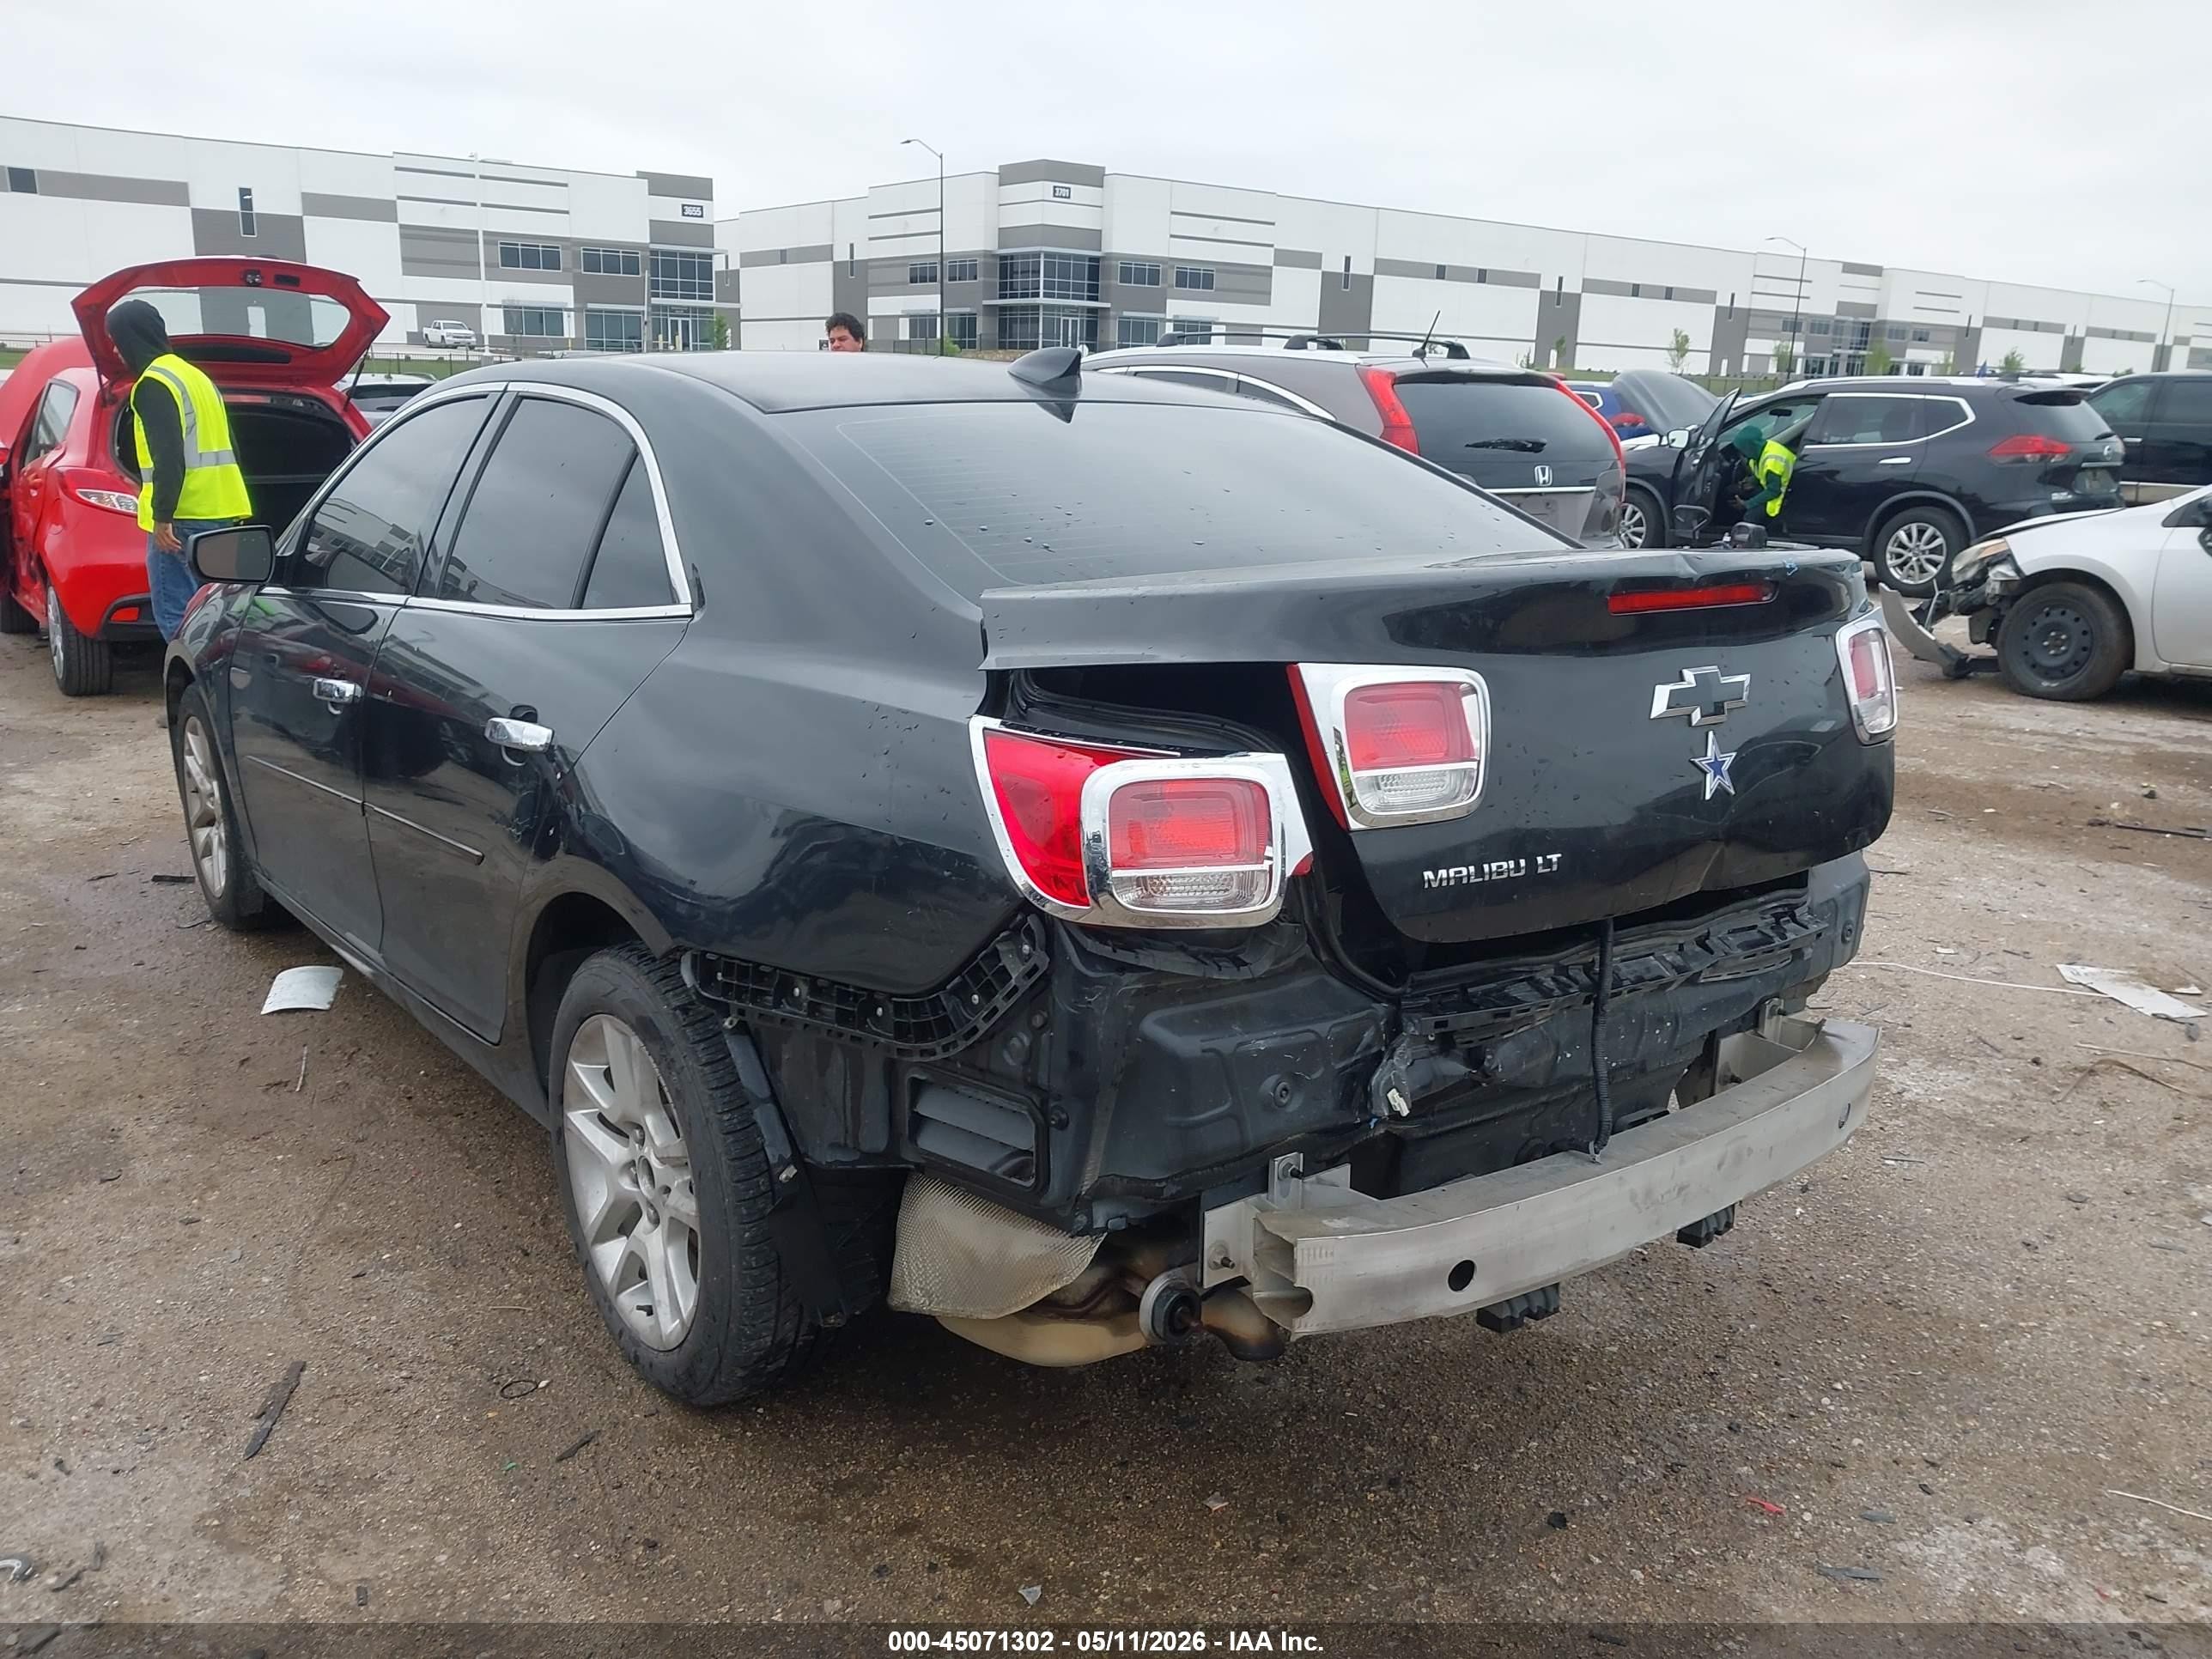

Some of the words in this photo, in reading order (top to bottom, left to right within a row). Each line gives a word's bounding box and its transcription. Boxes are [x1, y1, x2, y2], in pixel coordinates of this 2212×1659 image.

[1054, 187, 1070, 198] 3701
[1422, 858, 1526, 889] MALIBU
[1535, 854, 1562, 873] LT
